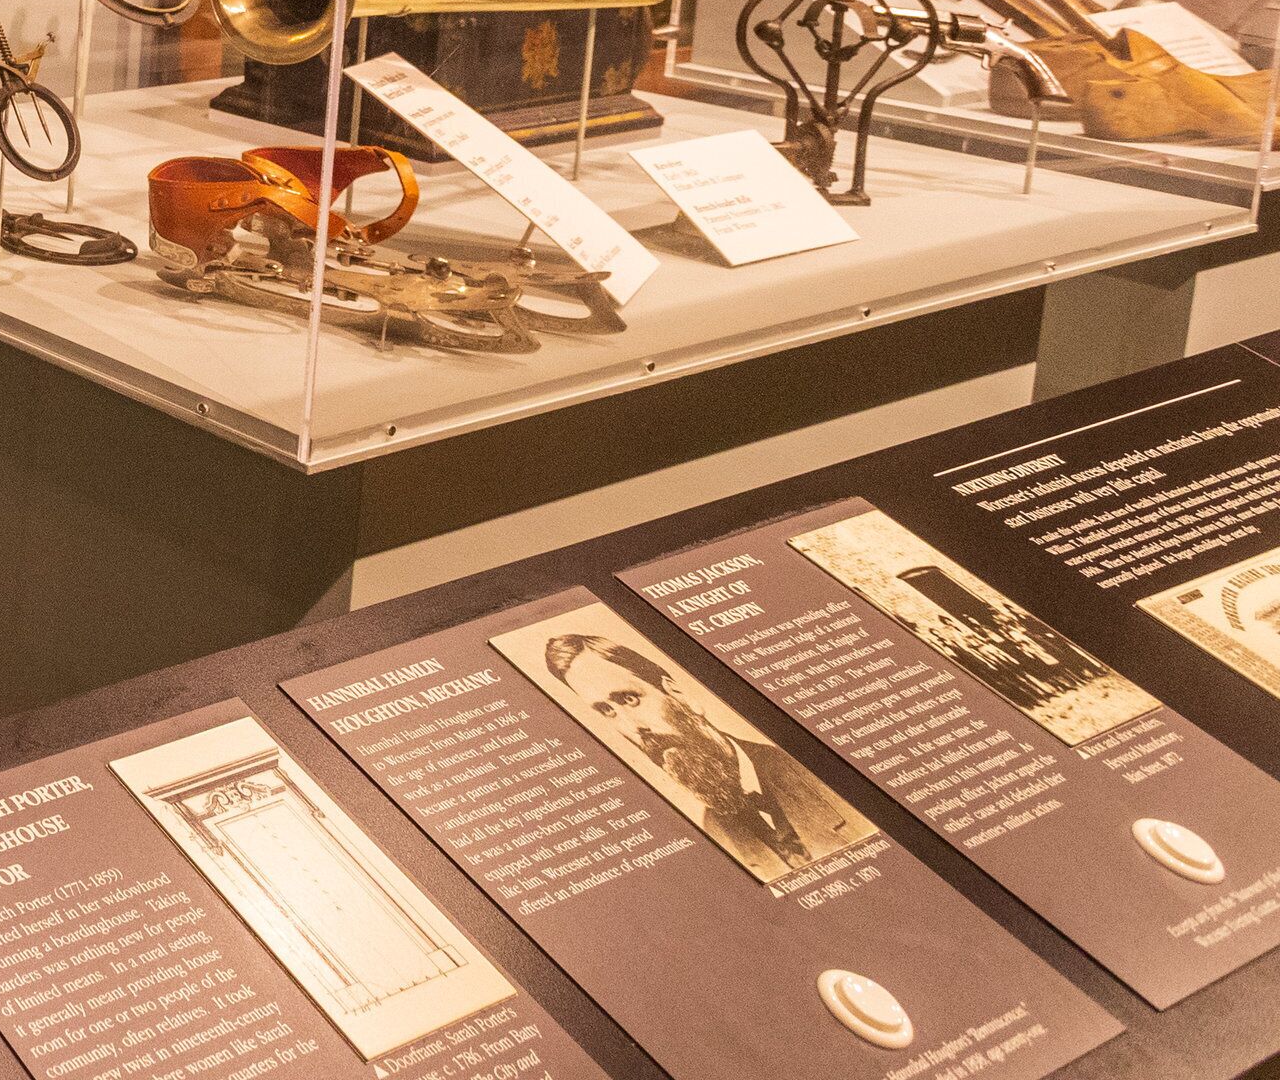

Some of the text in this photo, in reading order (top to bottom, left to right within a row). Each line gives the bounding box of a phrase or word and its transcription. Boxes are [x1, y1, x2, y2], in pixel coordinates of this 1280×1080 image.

[641, 553, 765, 599] THOMAS JACKSON,
[666, 579, 752, 618] A KNIGHT OF
[687, 601, 765, 635] ST. CRISPIN
[713, 600, 852, 653] Thomas Jackson was presiding officer
[305, 657, 445, 711] HANNIBAL HAMLIN
[329, 668, 501, 735] HOUGHTON, MECHANIC
[8, 775, 94, 811] PORTER,
[14, 893, 54, 914] Porter
[53, 867, 123, 900] (1771-1859)
[517, 836, 696, 916] offered an abundance of opportunities.
[776, 839, 892, 894] Hannibal Hamlin Houghton
[797, 865, 882, 910] (1827-1898), c. 1870
[19, 909, 64, 936] herself
[62, 908, 80, 920] in
[76, 899, 101, 915] her
[101, 871, 171, 905] widowhood
[41, 942, 53, 952] a
[49, 909, 144, 948] boardinghouse.
[144, 891, 191, 912] Taking
